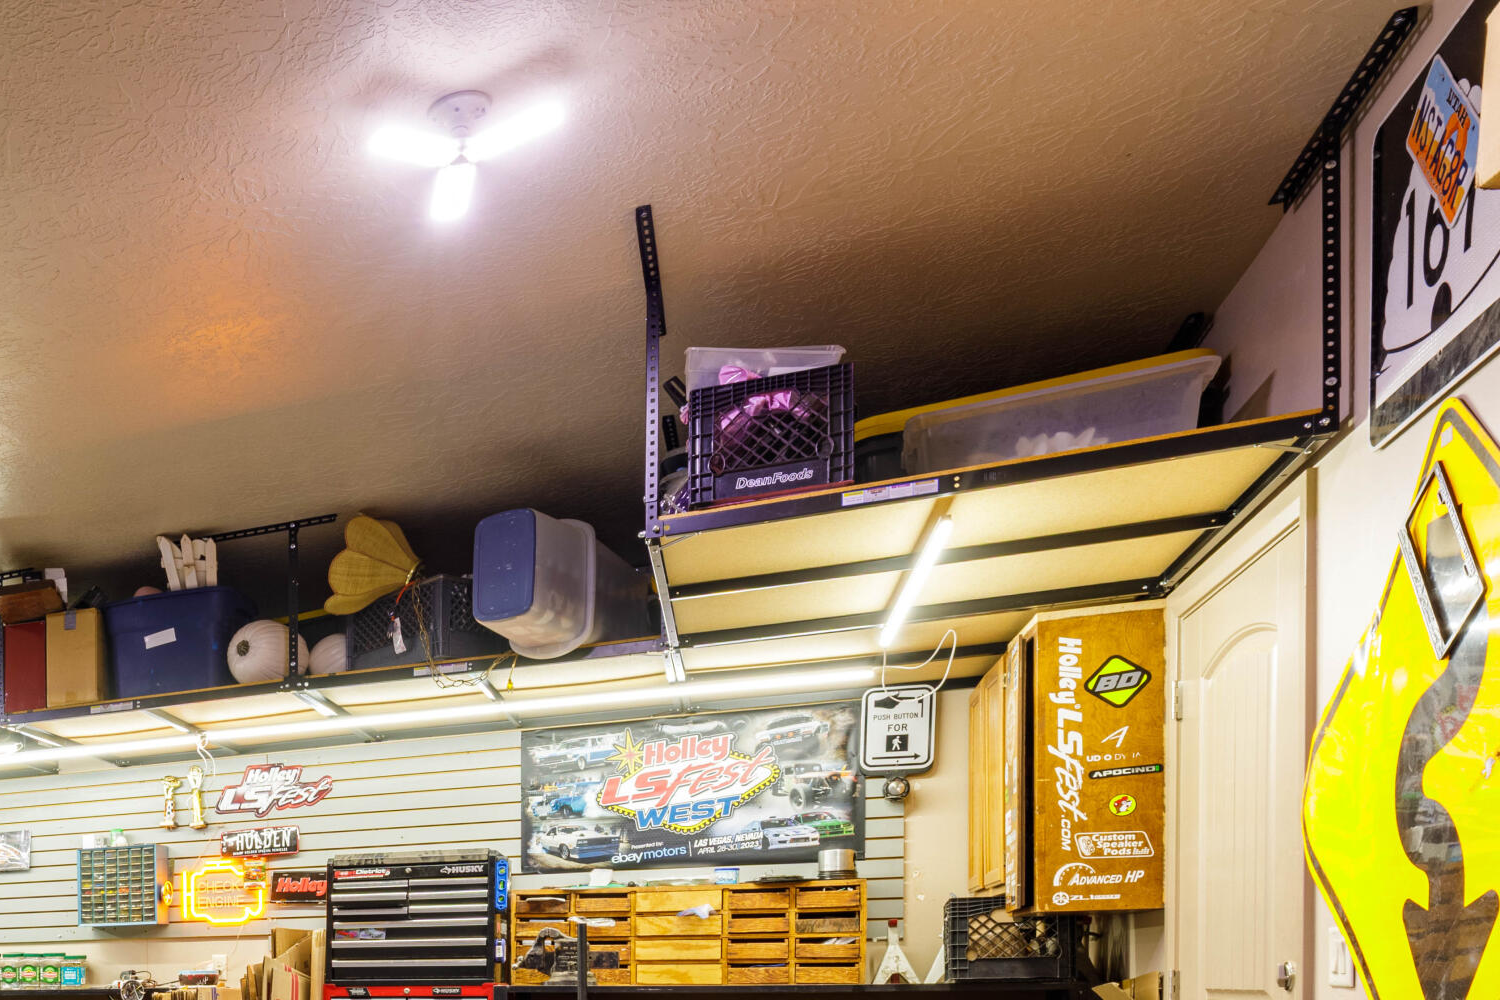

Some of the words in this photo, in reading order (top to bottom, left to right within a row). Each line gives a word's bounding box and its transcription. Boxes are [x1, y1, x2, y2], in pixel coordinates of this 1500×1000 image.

[1446, 87, 1469, 129] UTAH
[1411, 94, 1469, 210] NSTAG8R
[1048, 636, 1083, 705] Holley
[893, 712, 919, 720] BUTTON
[887, 723, 909, 732] FOR
[643, 735, 732, 766] Holley
[245, 766, 299, 784] Holley
[636, 795, 741, 829] WEST
[236, 829, 291, 851] HOLDEN
[694, 839, 708, 848] LAS
[734, 831, 764, 842] NEVADA
[1091, 833, 1136, 842] Custom
[1096, 840, 1144, 849] Speaker
[697, 847, 715, 855] APRIL
[1103, 847, 1132, 856] Pods
[451, 865, 484, 873] HUSKY
[1124, 870, 1145, 883] HP
[197, 879, 244, 893] CHECK
[276, 877, 327, 897] Holley
[197, 894, 246, 909] ENGINE
